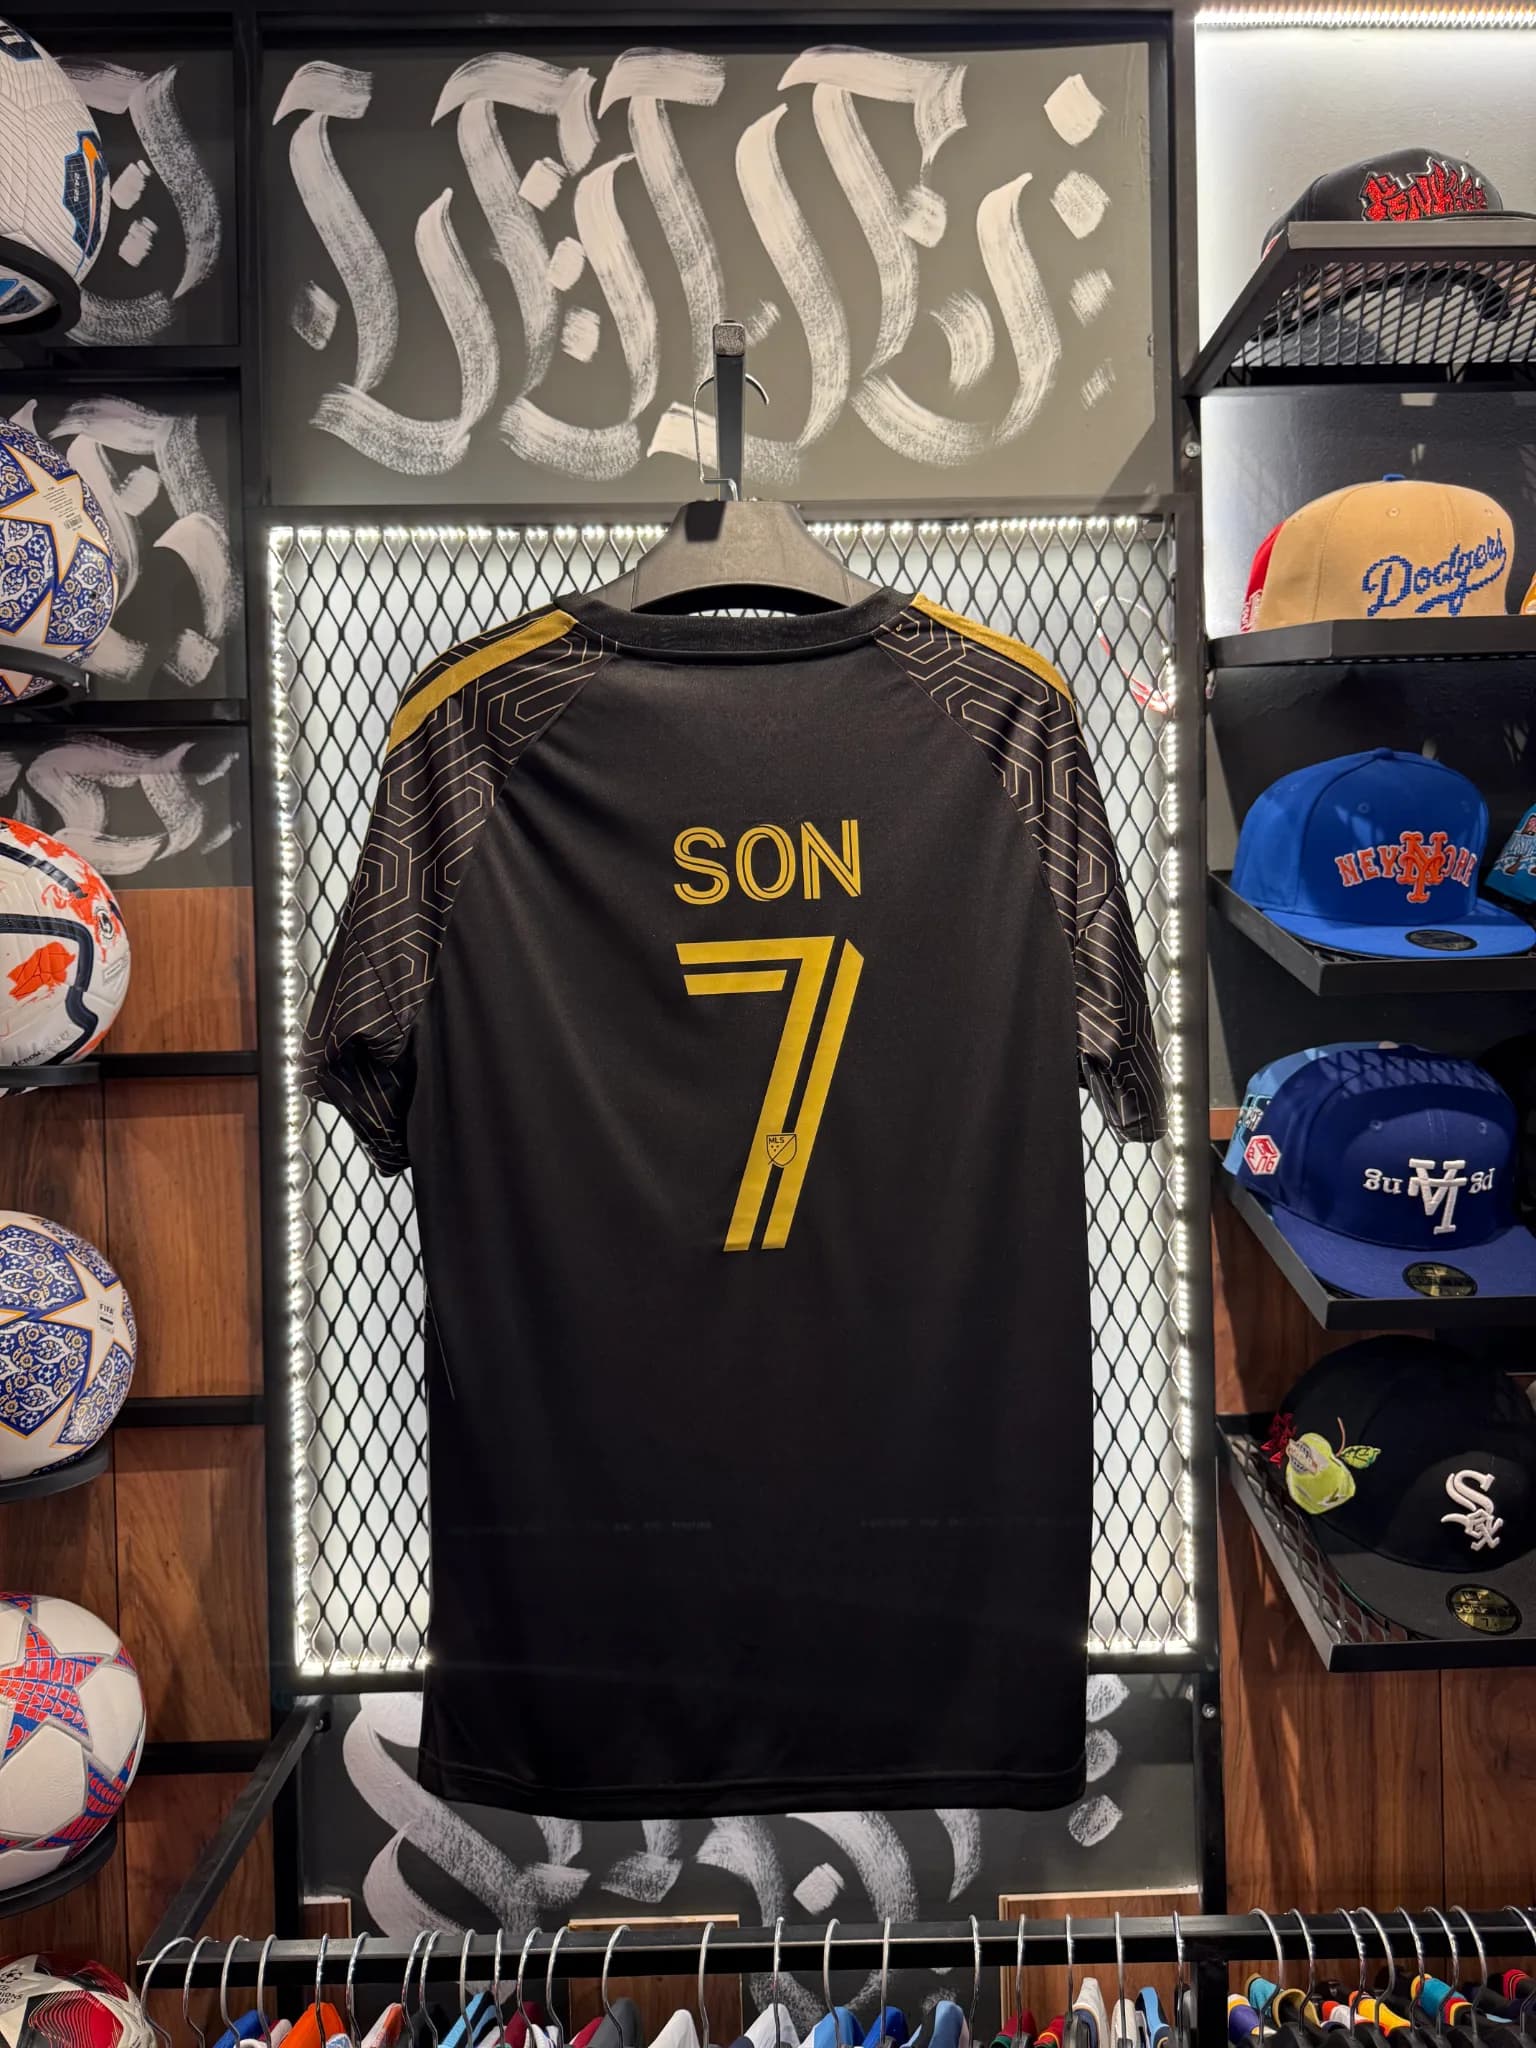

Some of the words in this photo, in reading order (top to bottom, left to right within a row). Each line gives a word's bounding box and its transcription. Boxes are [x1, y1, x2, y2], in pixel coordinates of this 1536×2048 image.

[1362, 528, 1507, 616] Dodgers
[673, 819, 862, 905] SON
[675, 935, 865, 1253] 7
[768, 1136, 785, 1144] MLS
